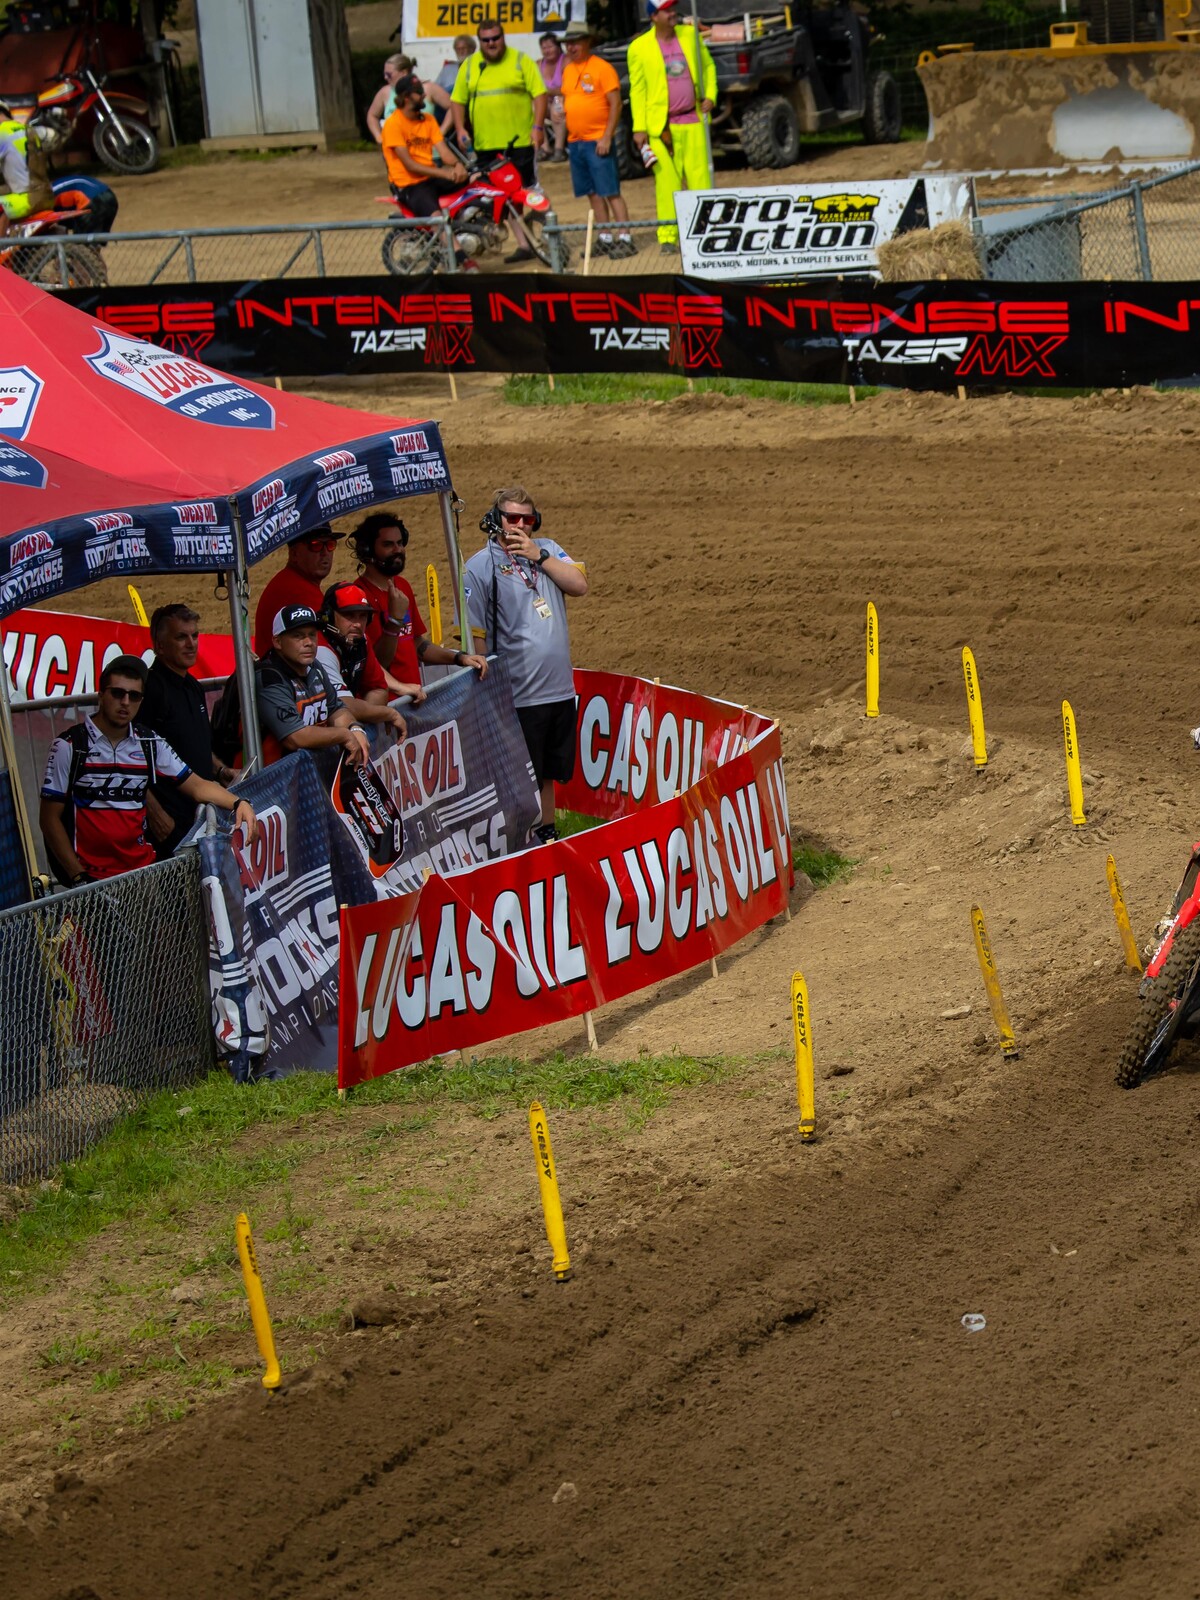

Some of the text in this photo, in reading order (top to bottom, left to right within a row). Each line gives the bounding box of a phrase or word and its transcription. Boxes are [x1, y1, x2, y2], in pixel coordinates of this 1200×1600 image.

[437, 2, 524, 26] ZIEGLER
[536, 0, 568, 22] CAT
[700, 215, 876, 254] action
[692, 261, 743, 270] SUSPENSION,
[747, 257, 780, 267] MOTORS,
[792, 255, 831, 264] COMPLETE
[834, 254, 868, 262] SERVICE
[236, 294, 473, 328] INTENSE
[489, 292, 724, 325] INTENSE
[746, 297, 1070, 334] INTENSE
[351, 328, 427, 354] TAZER
[589, 327, 671, 351] TAZER
[843, 335, 1069, 377] TAZER MX
[140, 361, 214, 399] LUCAS
[180, 387, 256, 417] OIL PRODUCTS
[228, 407, 261, 422] INC.
[394, 434, 415, 454] LUCAS
[253, 483, 274, 515] LUCAS
[317, 473, 375, 510] MOTOCROSS
[321, 493, 376, 518] CHAMPIONSHIP
[179, 504, 203, 524] LUCAS
[11, 536, 37, 566] LUCAS
[83, 537, 151, 570] MOTOCROSS
[173, 535, 235, 556] MOTOCROSS
[290, 608, 311, 621] FXR
[965, 661, 977, 702] ACERBIS
[578, 695, 651, 803] CAS
[1065, 715, 1075, 759] ACERBIS
[377, 726, 460, 813] UCAS OIL
[600, 808, 729, 966] LUCAS
[720, 780, 778, 902] OIL
[353, 872, 589, 1049] LUCAS OIL
[977, 919, 994, 969] ACERBIS
[795, 991, 809, 1048] ACERBIS
[536, 1121, 552, 1180] ACERBIS
